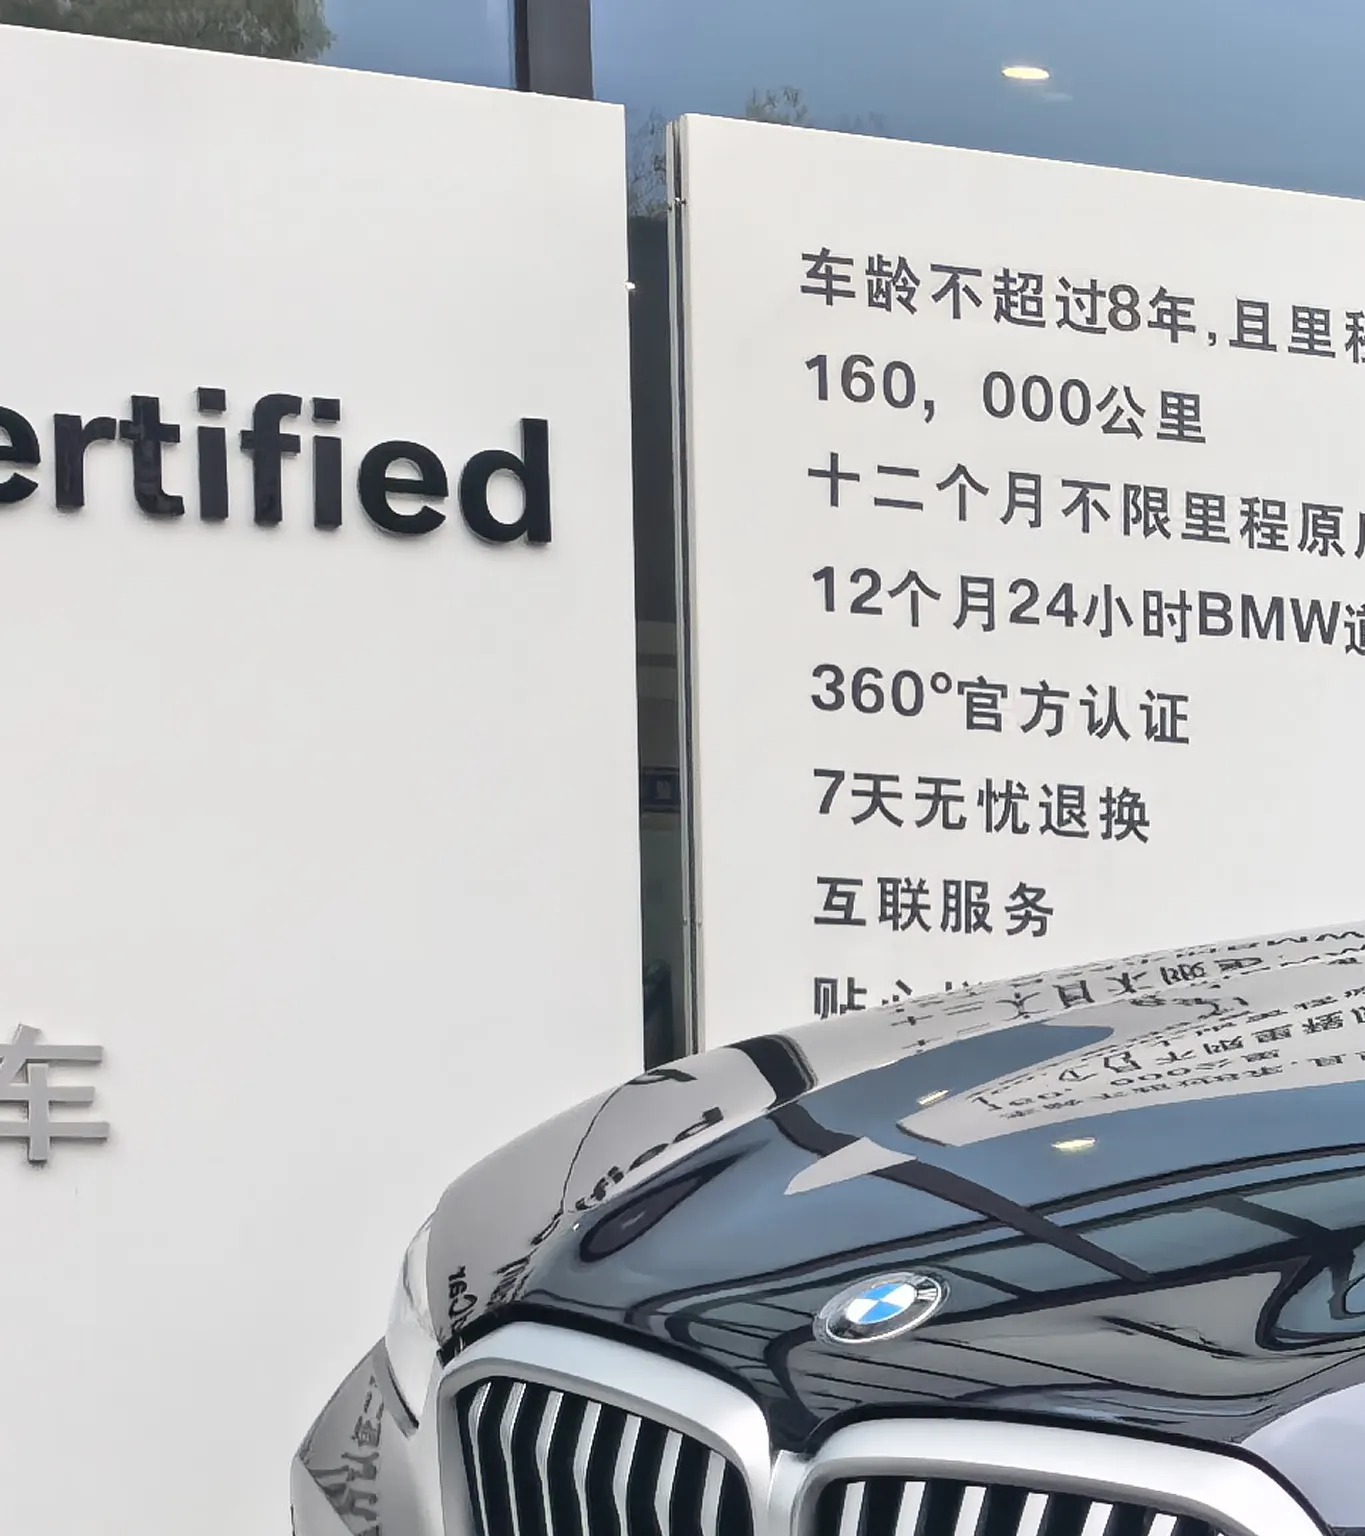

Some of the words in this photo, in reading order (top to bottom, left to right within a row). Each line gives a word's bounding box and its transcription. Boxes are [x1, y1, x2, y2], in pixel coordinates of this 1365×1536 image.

[813, 768, 1150, 844] 7天无忧退换
[813, 876, 1054, 938] 互联服务
[0, 1023, 111, 1164] 车
